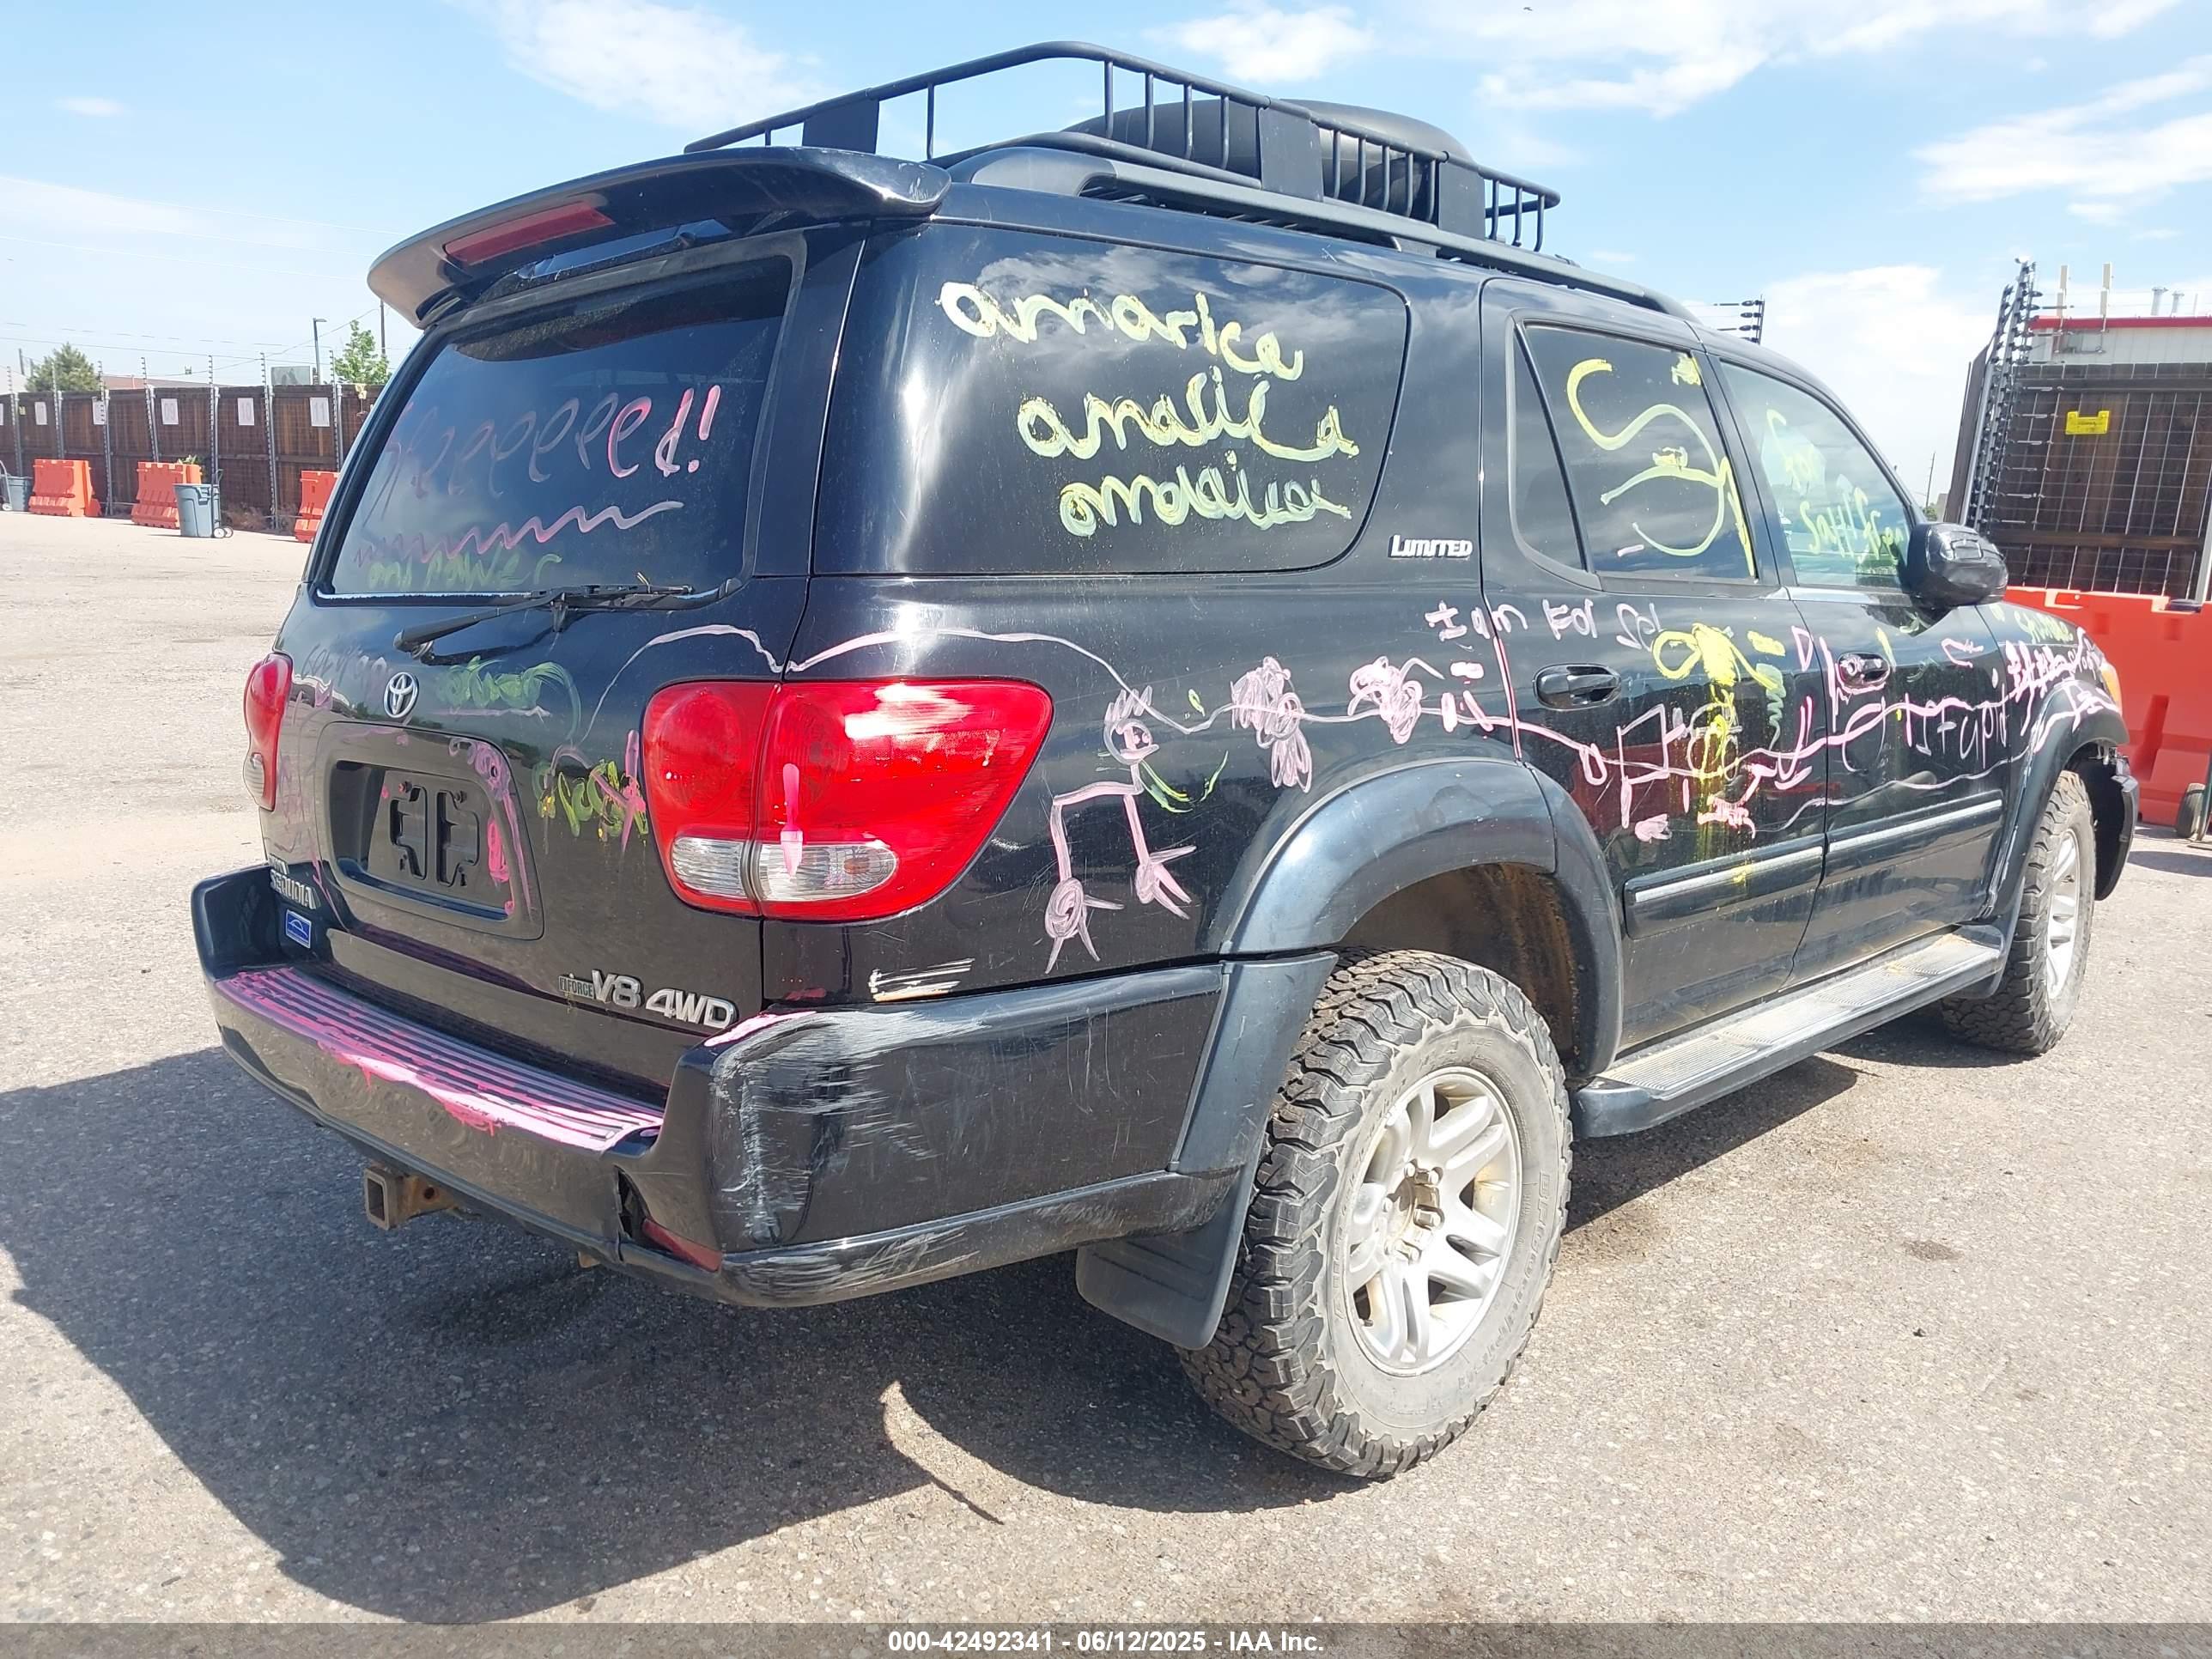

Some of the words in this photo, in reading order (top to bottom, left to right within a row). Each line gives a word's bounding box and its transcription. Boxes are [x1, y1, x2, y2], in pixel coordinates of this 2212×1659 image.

[1388, 534, 1474, 558] LIMITED
[591, 969, 642, 1009] V8
[645, 988, 739, 1030] 4WD
